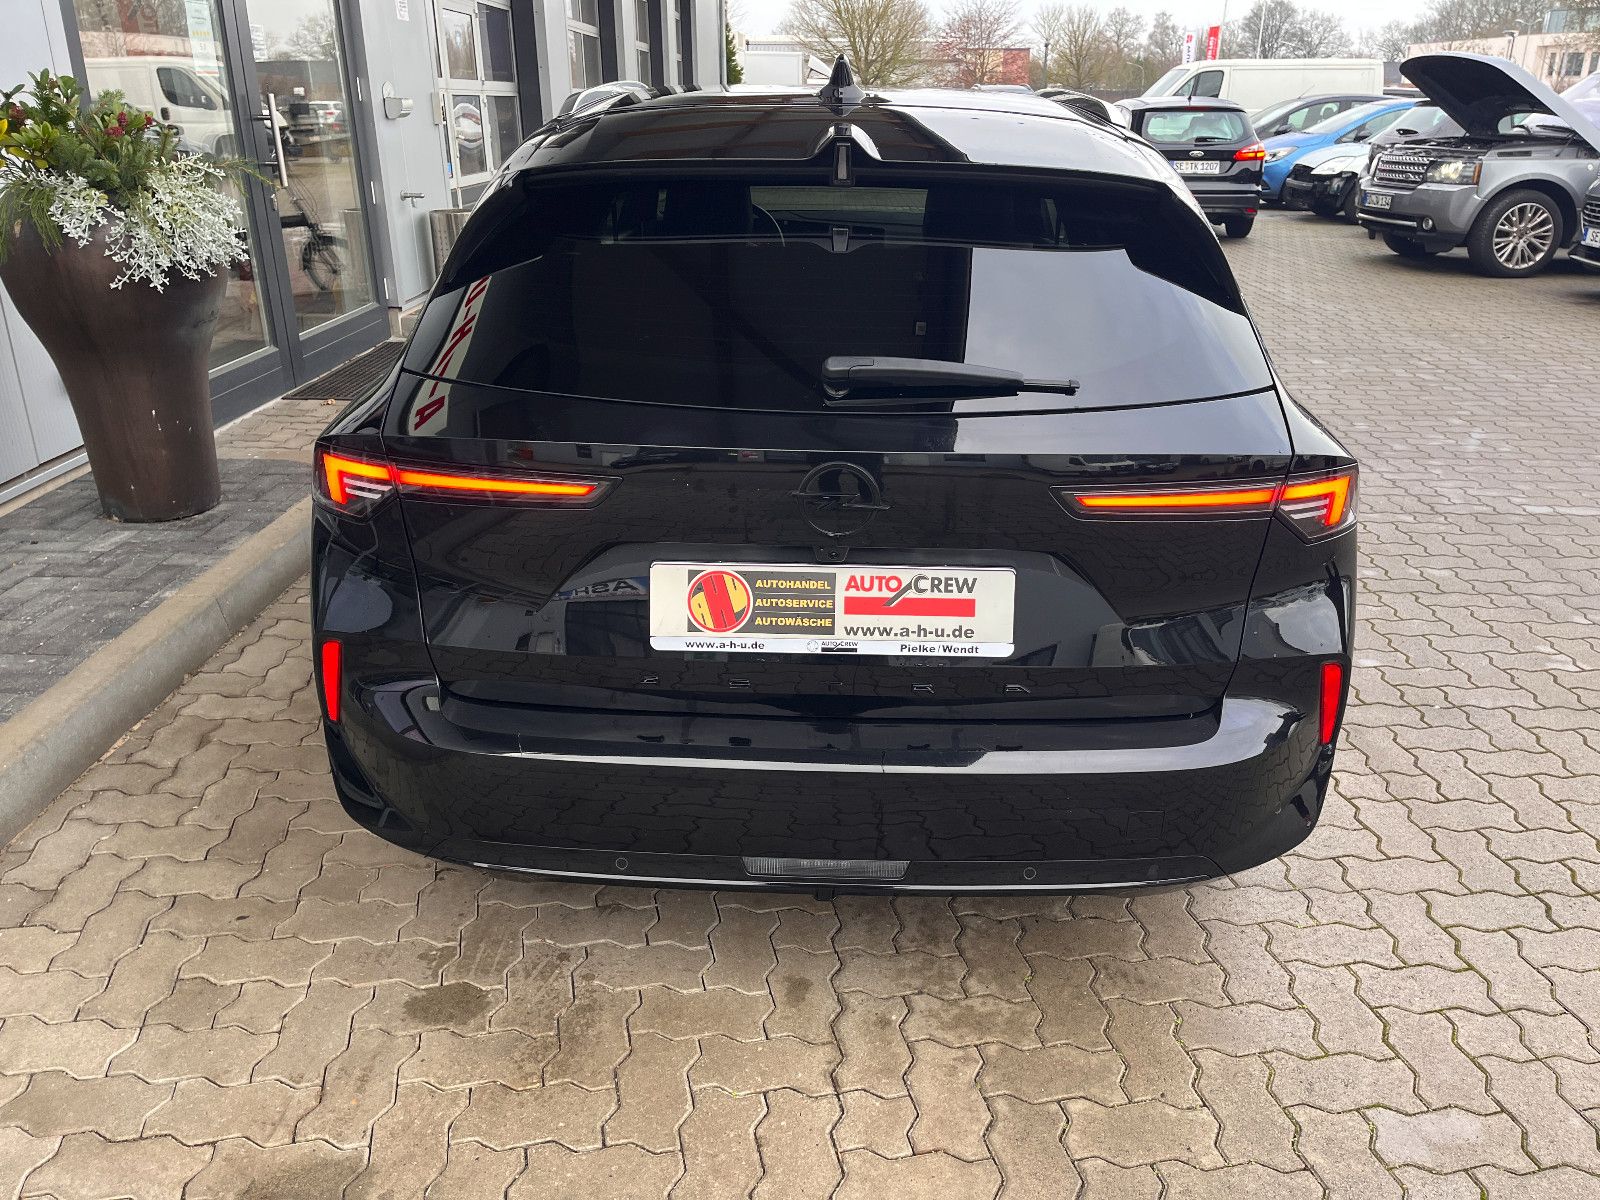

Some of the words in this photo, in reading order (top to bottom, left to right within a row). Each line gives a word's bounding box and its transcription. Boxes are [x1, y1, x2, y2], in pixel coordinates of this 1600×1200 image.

[1175, 162, 1184, 170] SE
[1190, 162, 1199, 171] TK
[1201, 162, 1219, 171] 1207
[755, 579, 831, 590] AUTOHANDEL
[845, 575, 902, 593] AUTO
[913, 574, 977, 594] CREW
[755, 598, 833, 609] AUTOSERVICE
[755, 616, 833, 627] AUTOWÄSCHE
[844, 624, 975, 639] www.a-h-u.de
[685, 641, 765, 650] www.a-h-u.de
